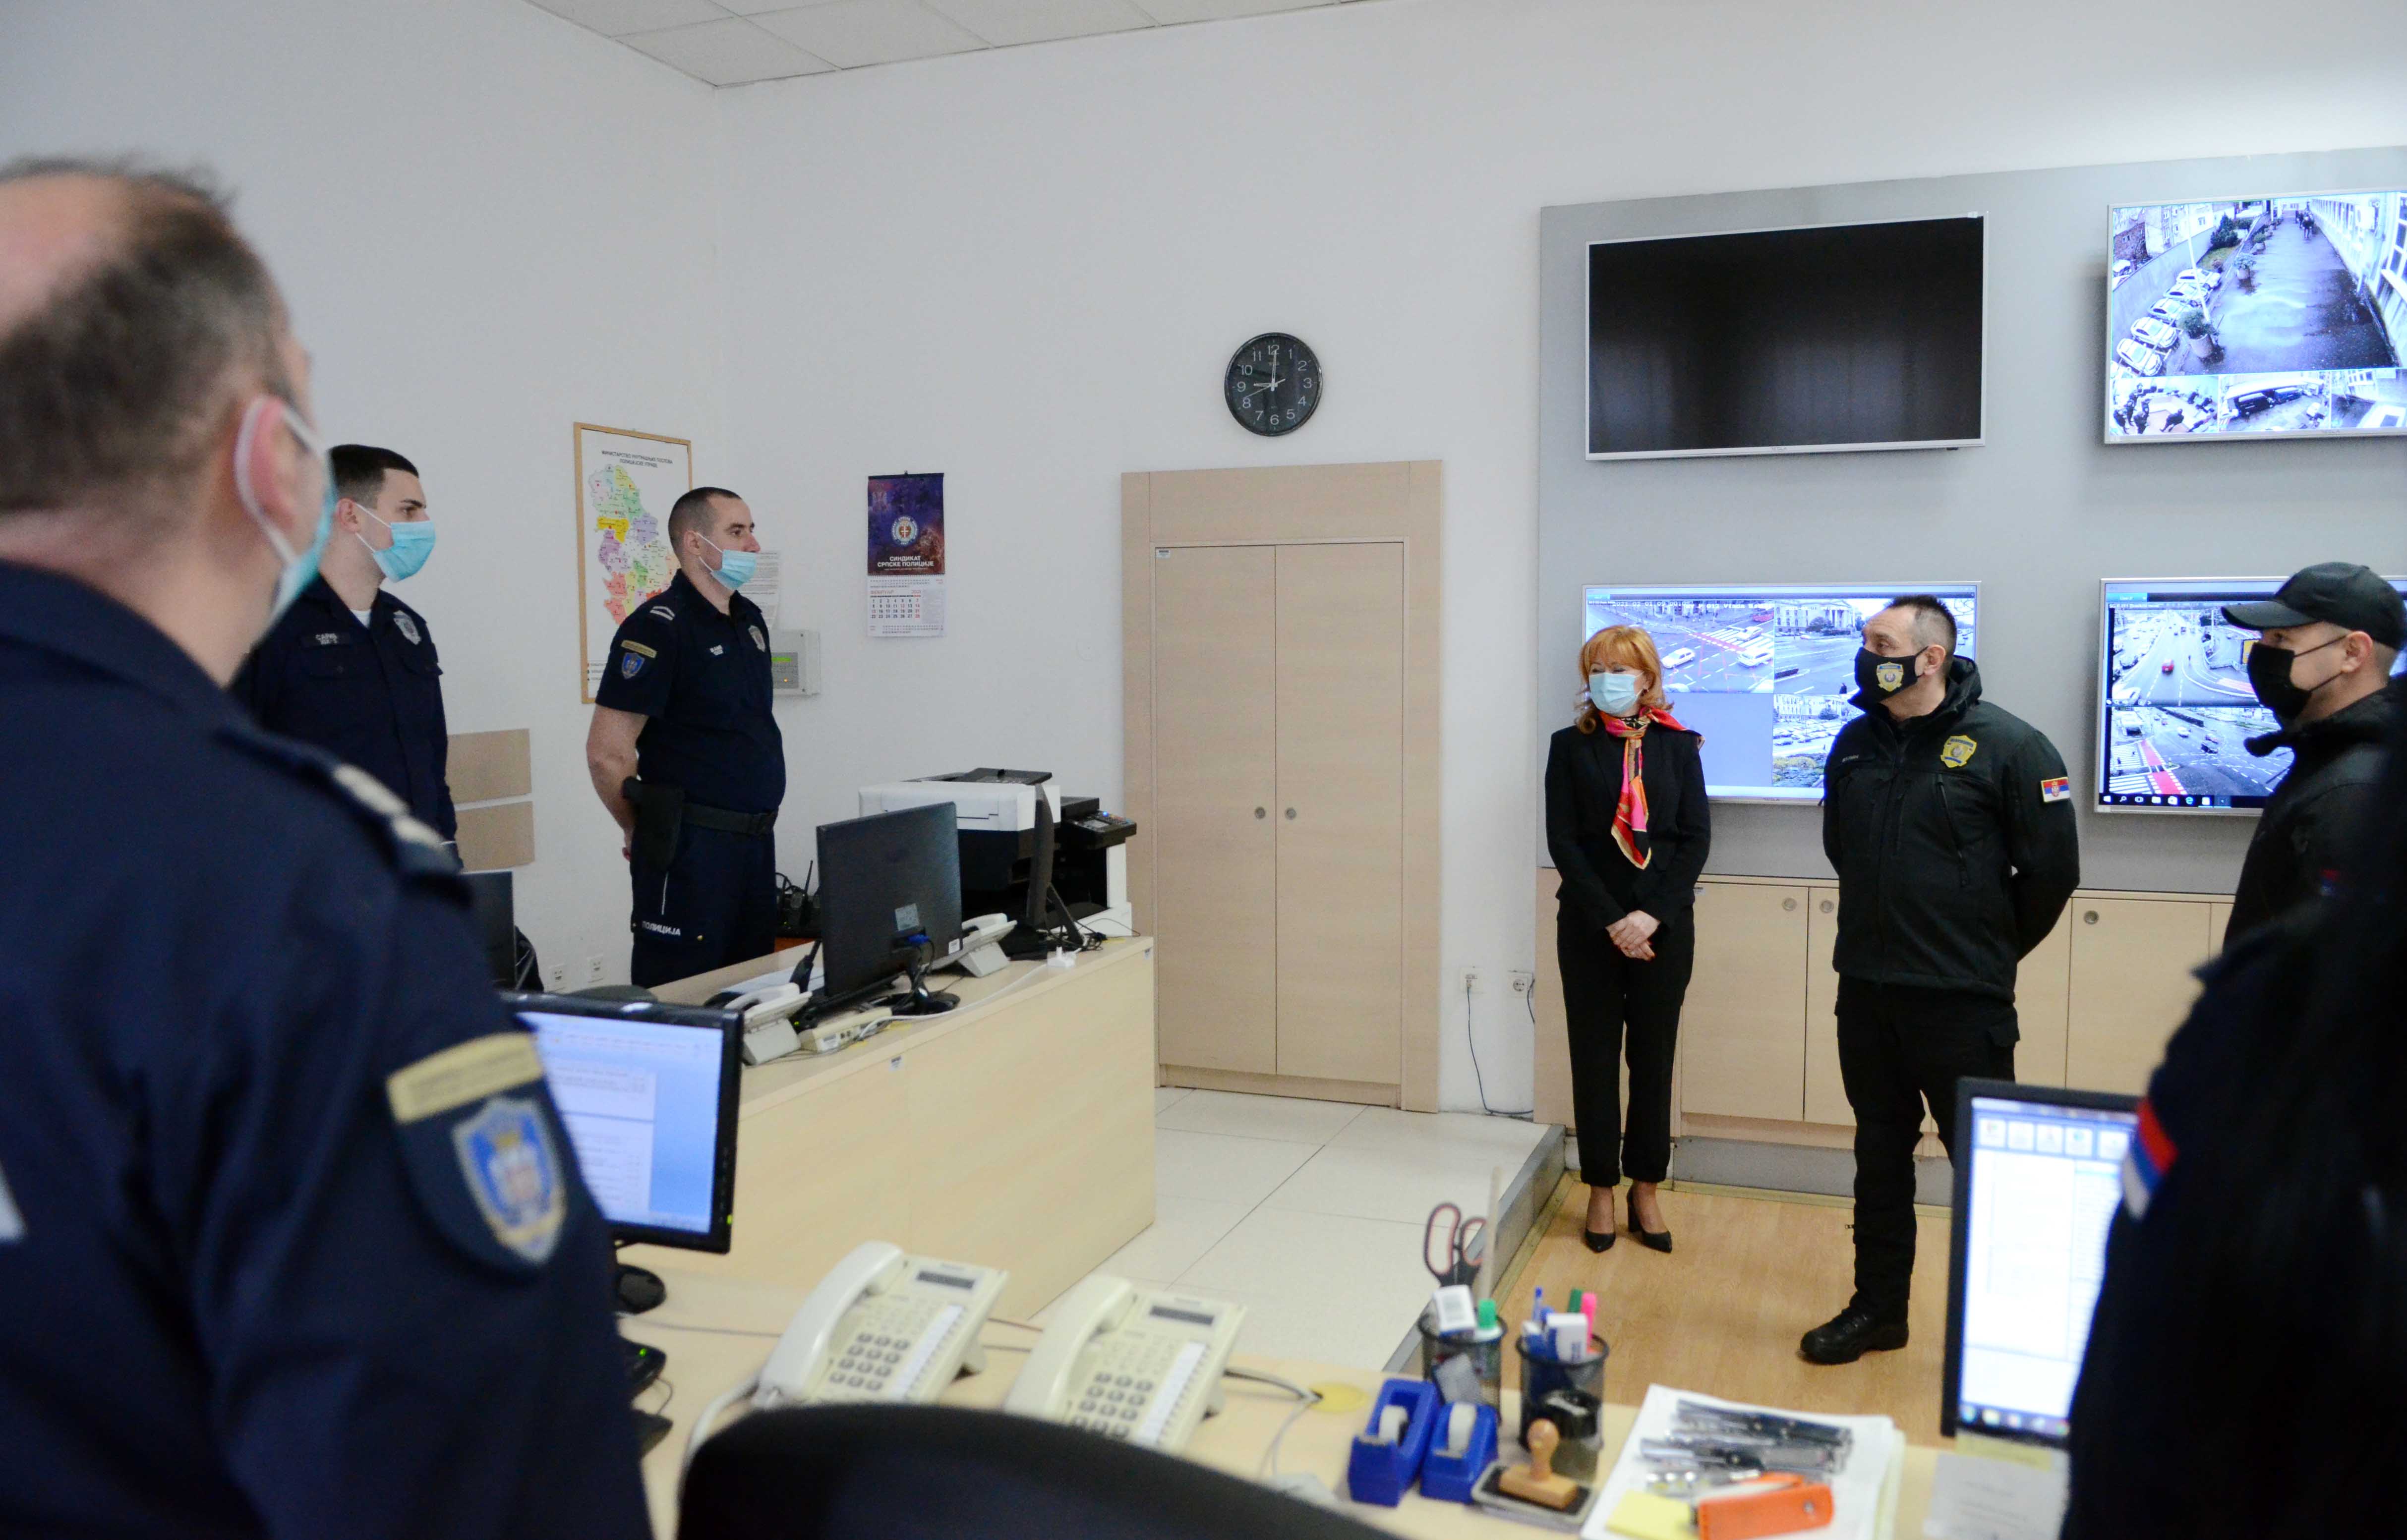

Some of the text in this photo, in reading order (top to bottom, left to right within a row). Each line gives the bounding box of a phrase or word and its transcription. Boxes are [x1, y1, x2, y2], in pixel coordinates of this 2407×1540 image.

[1268, 344, 1280, 355] 12
[1289, 348, 1292, 359] 1
[1253, 350, 1262, 361] 11
[1241, 364, 1253, 375] 10
[1298, 360, 1307, 371] 2
[1237, 381, 1246, 392] 9
[1303, 378, 1312, 389] 3
[1242, 398, 1251, 408] 8
[1297, 396, 1306, 406] 4
[1255, 410, 1263, 421] 7
[1270, 414, 1279, 425] 6
[1286, 409, 1295, 419] 5
[643, 921, 681, 936] ПОЛИЦИЈА
